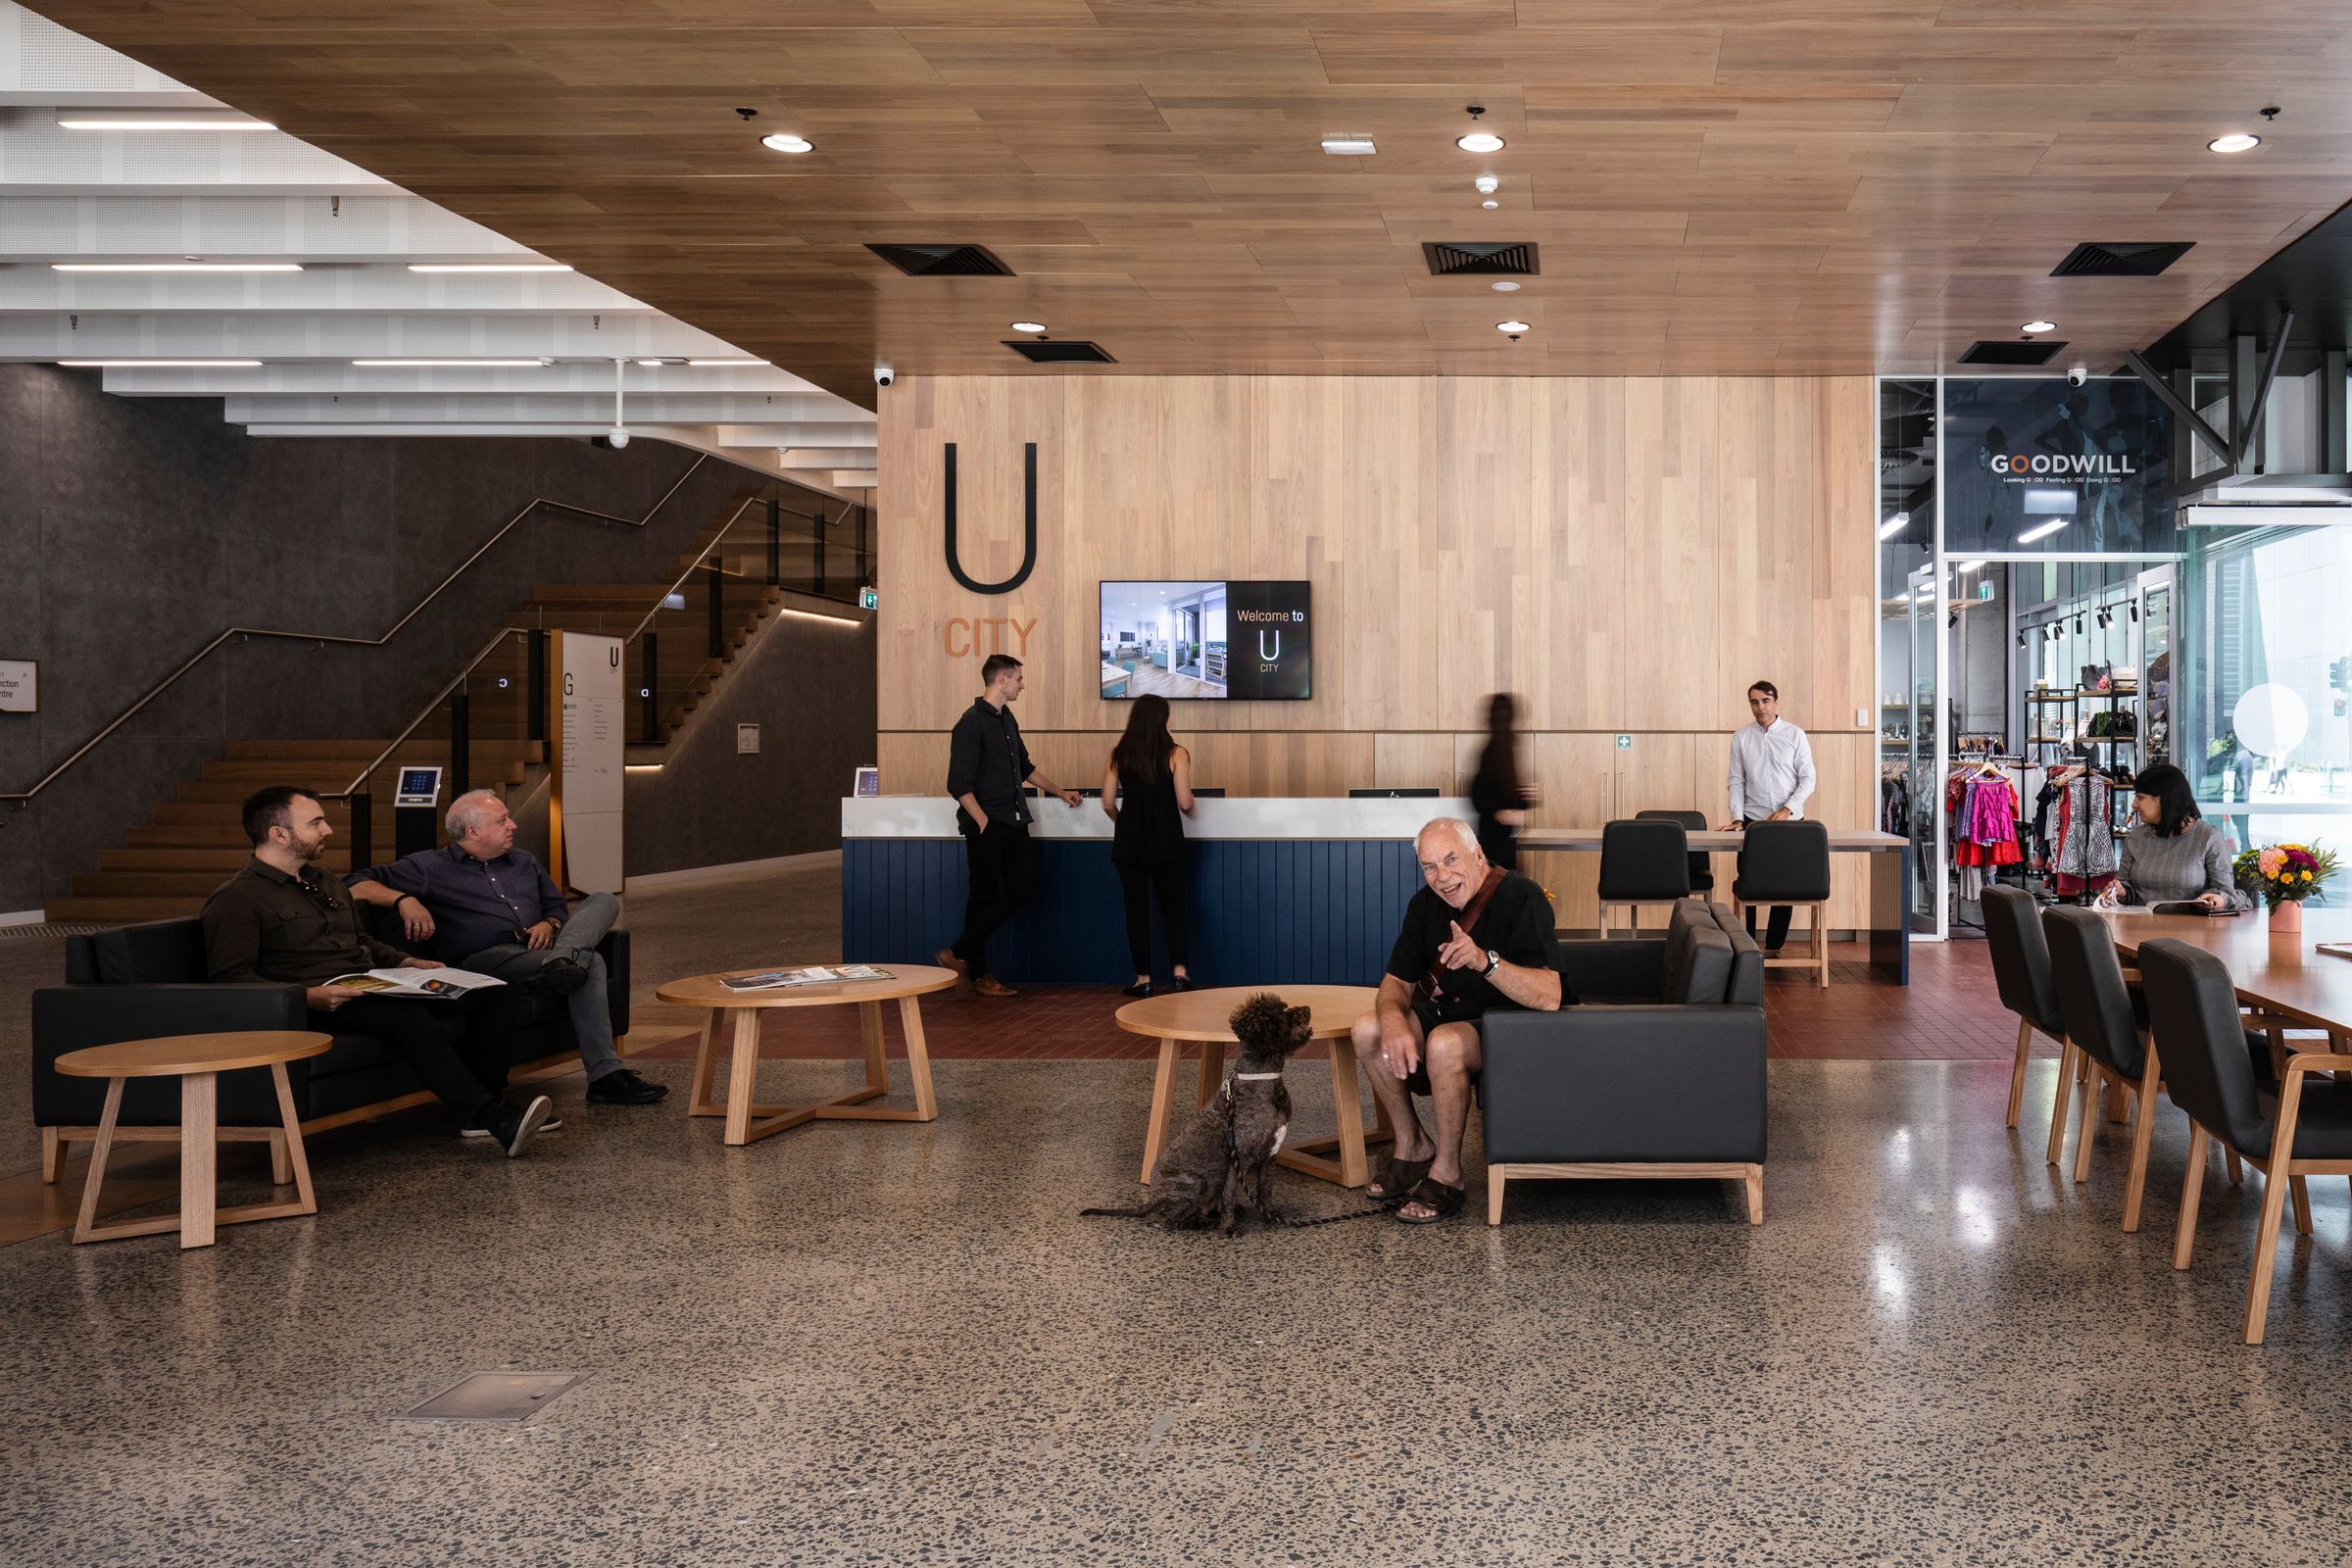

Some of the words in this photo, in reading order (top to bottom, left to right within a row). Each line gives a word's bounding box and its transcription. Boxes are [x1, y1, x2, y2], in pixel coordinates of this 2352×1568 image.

[1990, 455, 2135, 473] GOODWILL
[945, 443, 1037, 595] U
[1237, 610, 1290, 621] Welcome
[1292, 610, 1304, 621] to
[945, 617, 1037, 659] CITY
[1259, 629, 1280, 662] U
[610, 646, 619, 667] U
[1259, 663, 1279, 673] CITY
[564, 672, 573, 696] G
